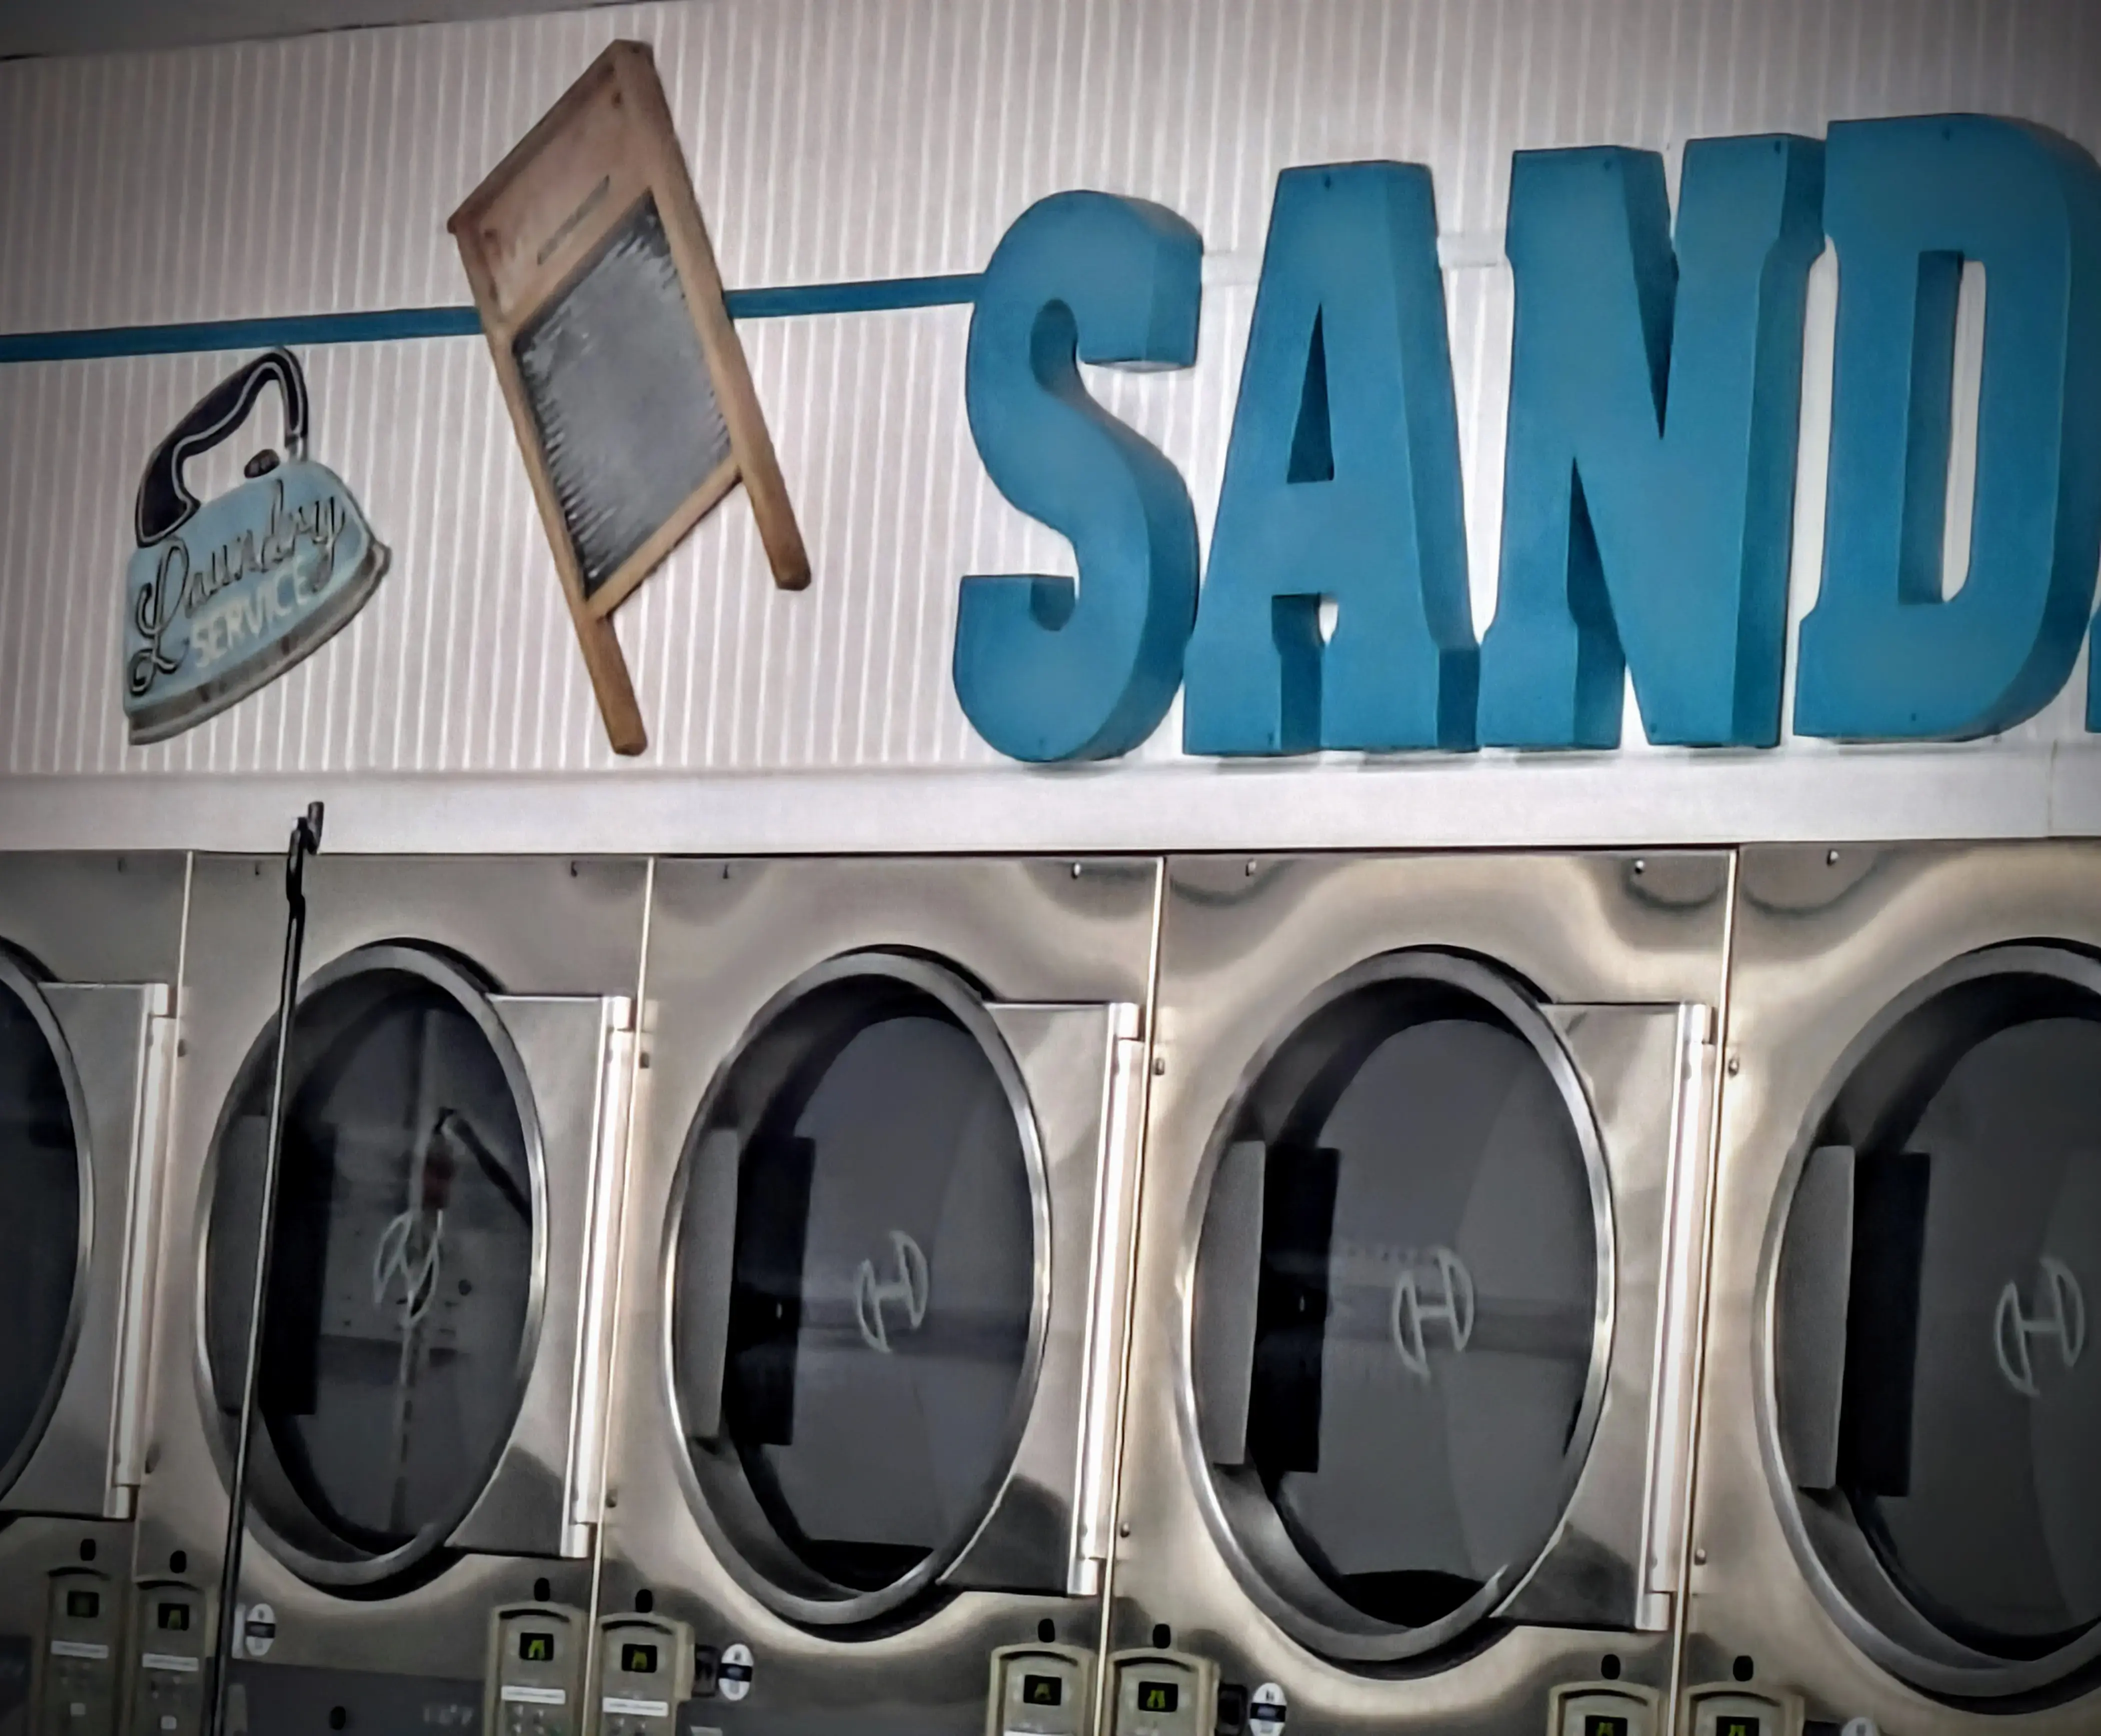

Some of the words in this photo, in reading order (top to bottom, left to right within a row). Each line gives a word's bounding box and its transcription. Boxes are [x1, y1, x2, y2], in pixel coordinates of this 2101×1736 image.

[953, 114, 2101, 764] SAND
[129, 478, 346, 698] Laundry
[191, 553, 313, 668] SERVICE
